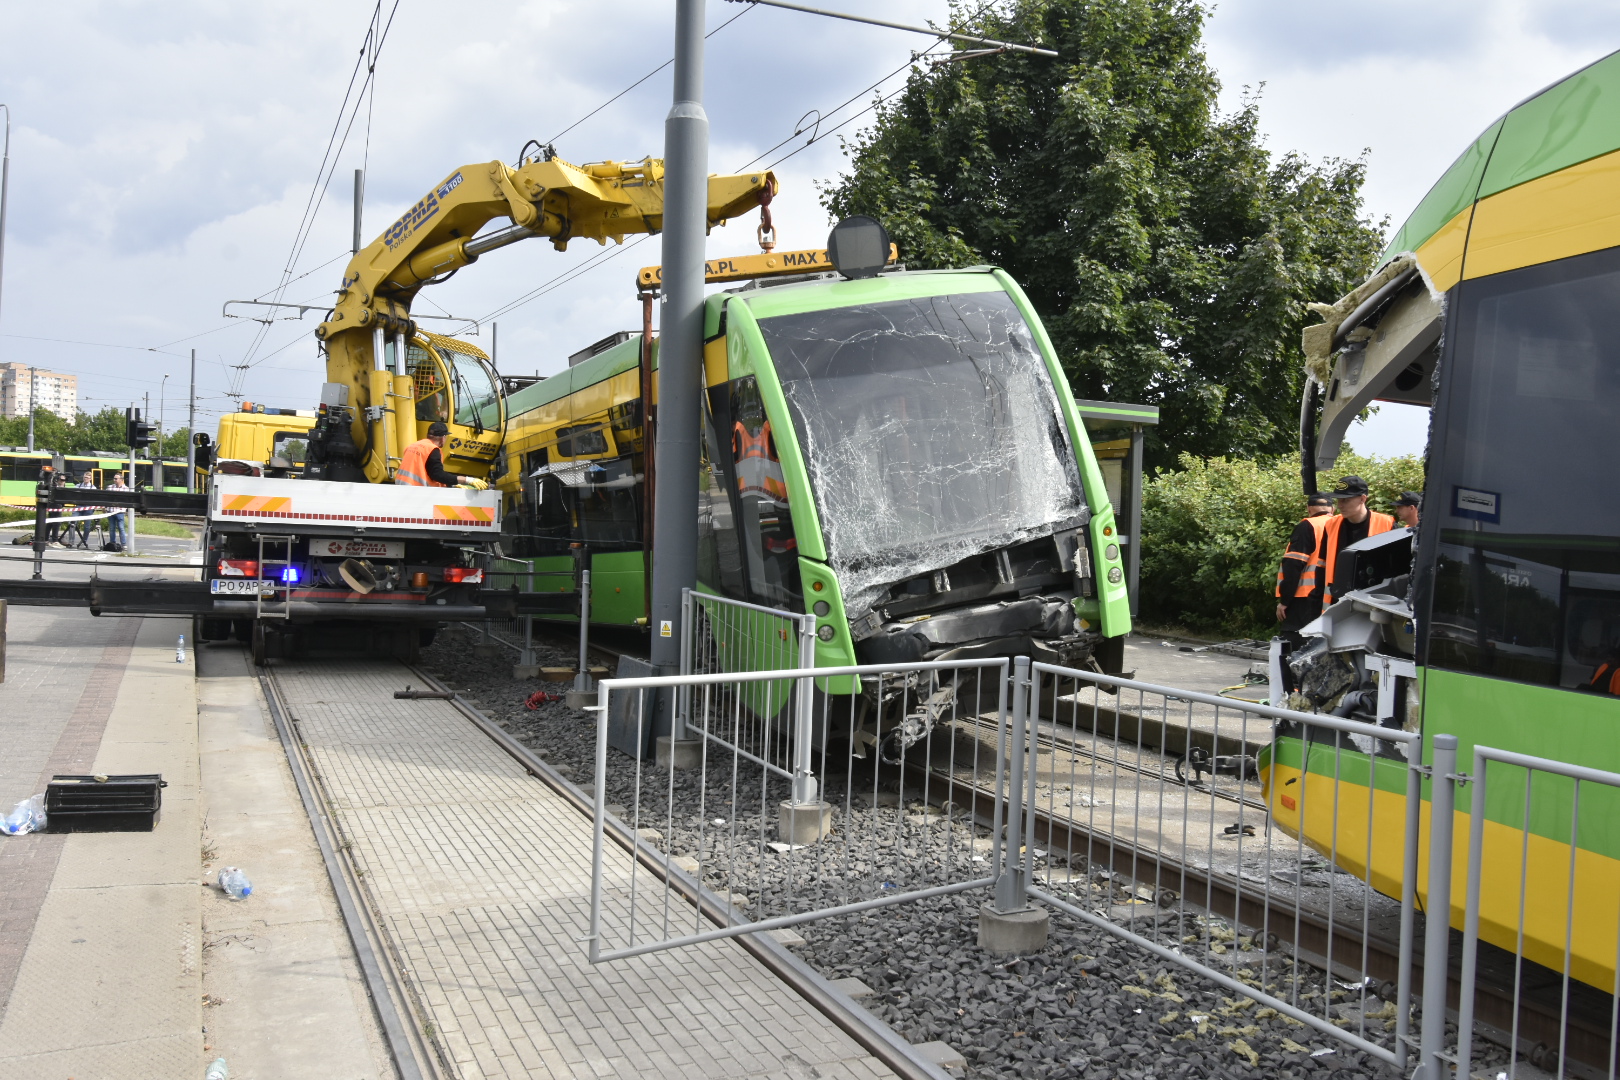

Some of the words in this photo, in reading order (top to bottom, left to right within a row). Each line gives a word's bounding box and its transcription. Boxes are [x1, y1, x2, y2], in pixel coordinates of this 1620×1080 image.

[384, 192, 438, 246] COPMA
[389, 229, 413, 253] Polska
[783, 252, 818, 266] MAX
[345, 542, 387, 552] COPMA
[218, 581, 235, 591] PO
